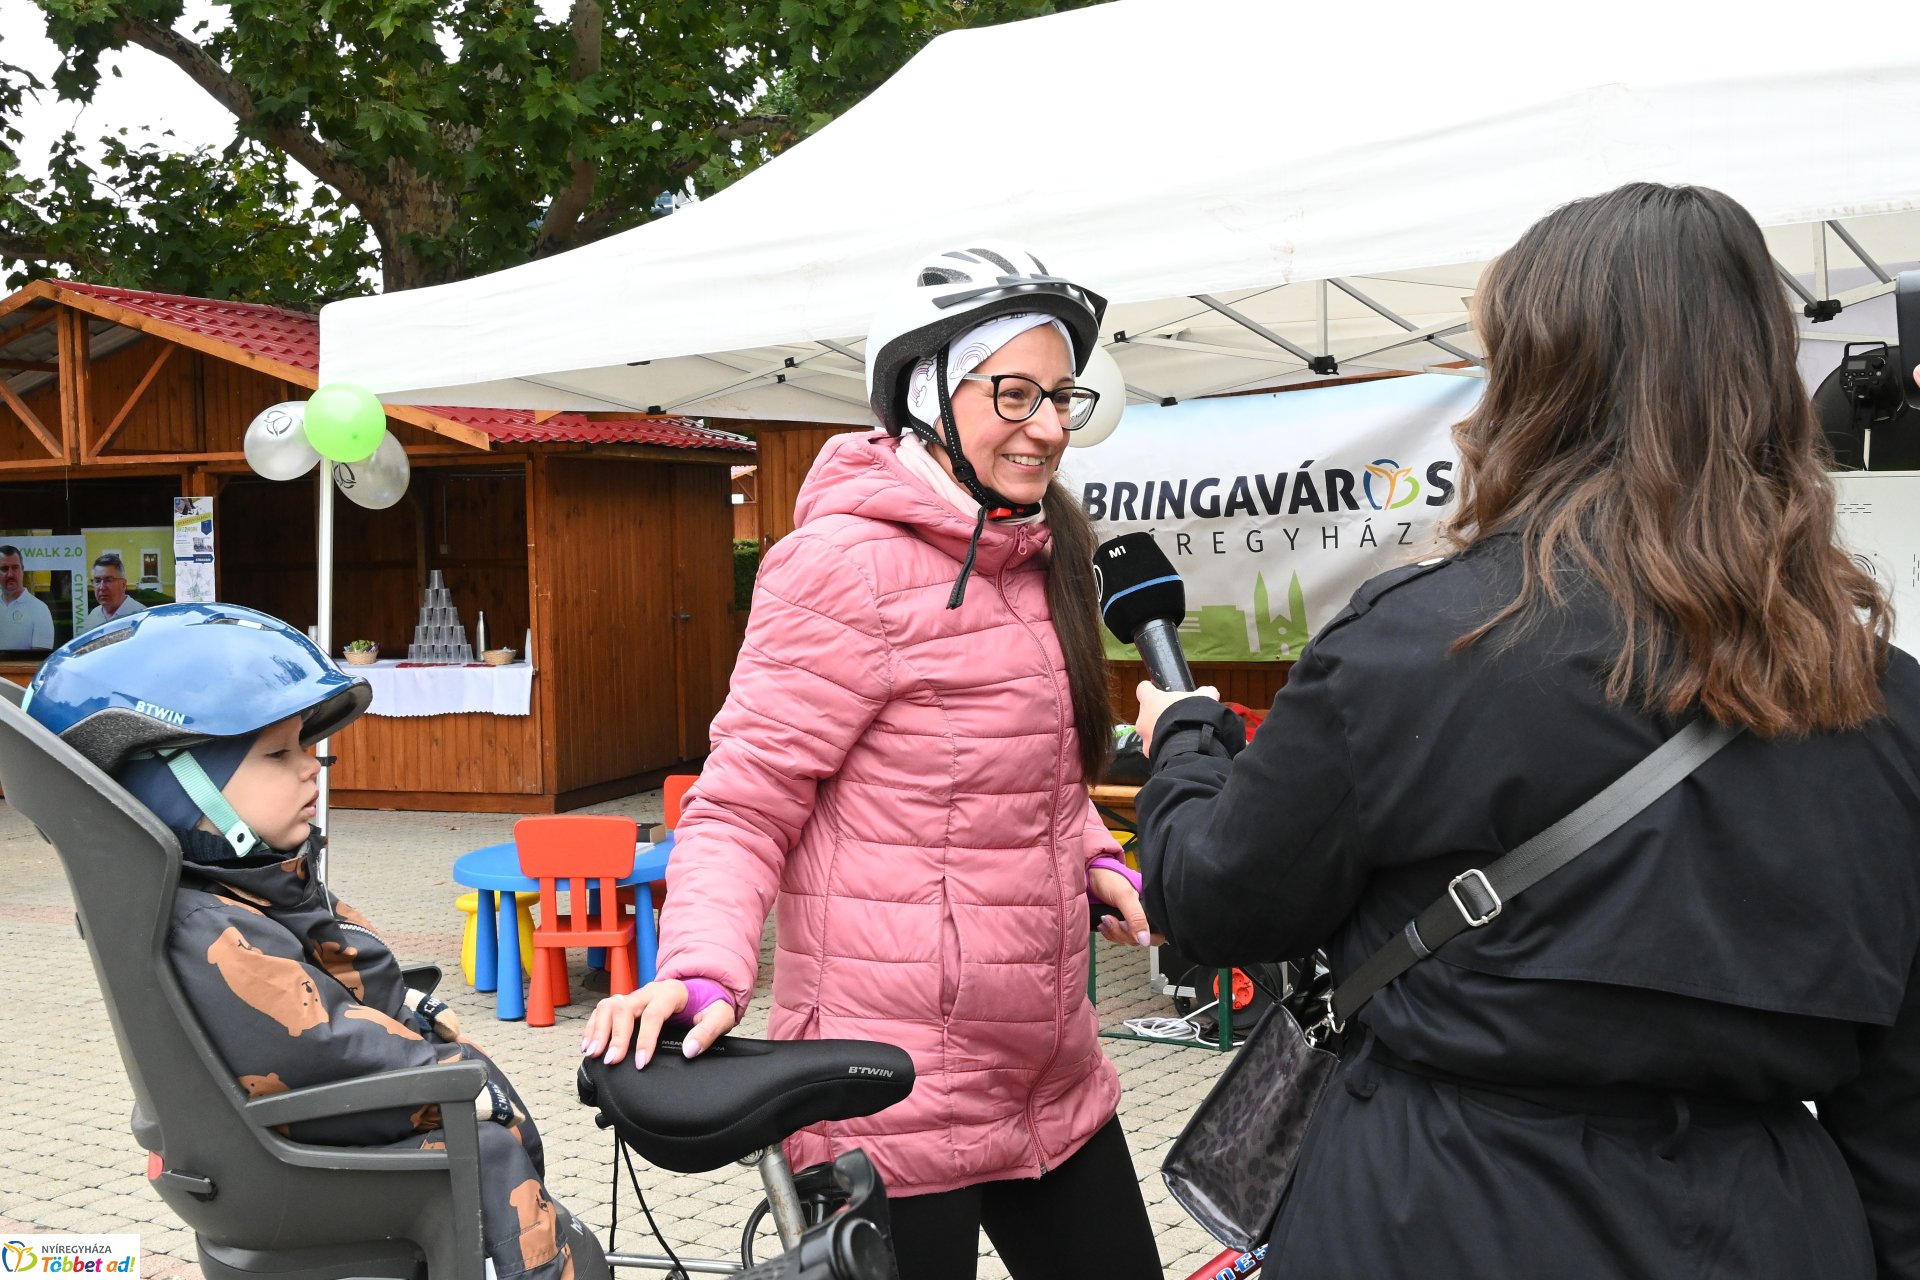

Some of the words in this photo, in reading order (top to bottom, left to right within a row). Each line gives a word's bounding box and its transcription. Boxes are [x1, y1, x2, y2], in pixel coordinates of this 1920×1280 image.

[20, 547, 60, 558] WALK
[64, 546, 83, 557] 2.0
[1108, 545, 1127, 559] M1
[74, 573, 85, 636] CITYWAL
[134, 700, 186, 726] BTWIN
